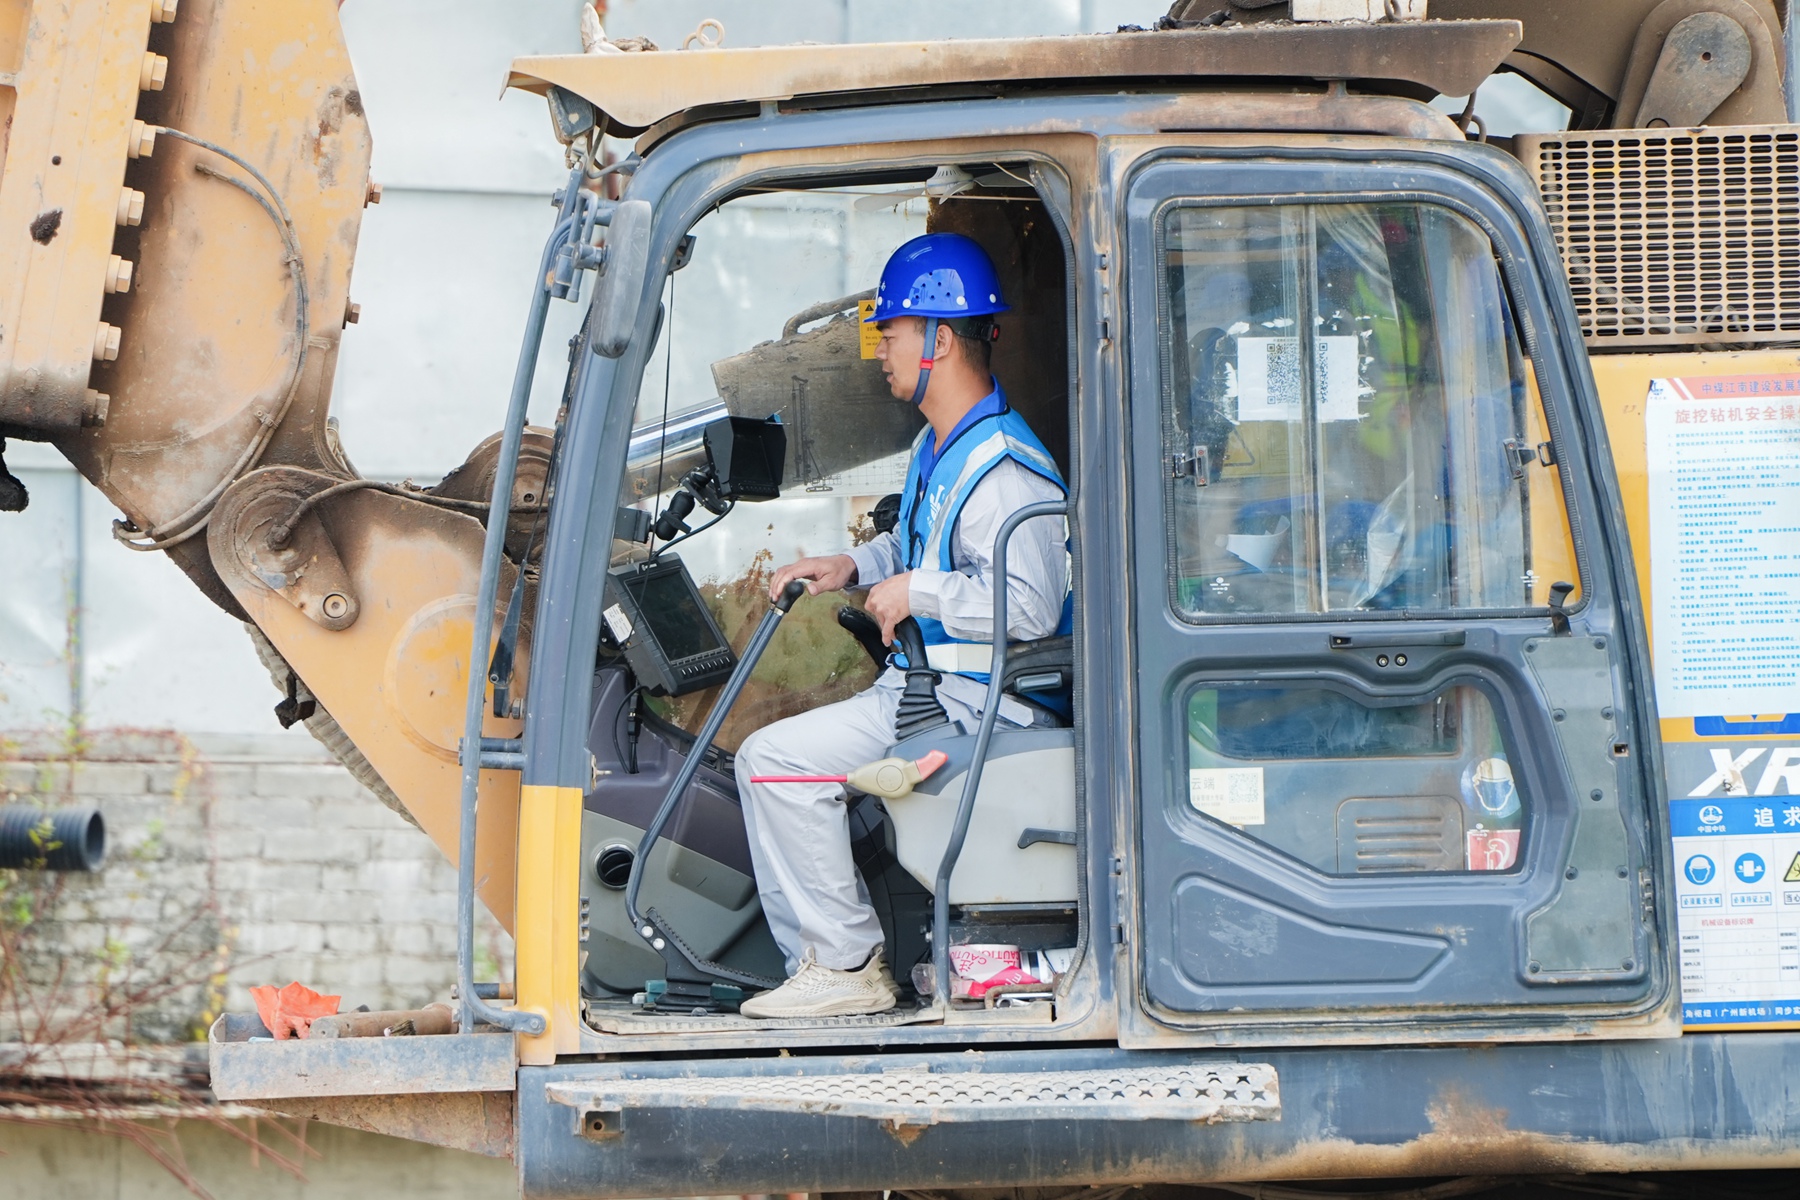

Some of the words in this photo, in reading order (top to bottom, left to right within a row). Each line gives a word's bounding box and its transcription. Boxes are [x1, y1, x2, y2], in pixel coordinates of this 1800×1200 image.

[1191, 777, 1215, 790] 云端
[1697, 825, 1726, 833] 中国中铁
[1733, 895, 1770, 904] 必须持证上岗
[1701, 917, 1754, 927] 机械设备标识牌
